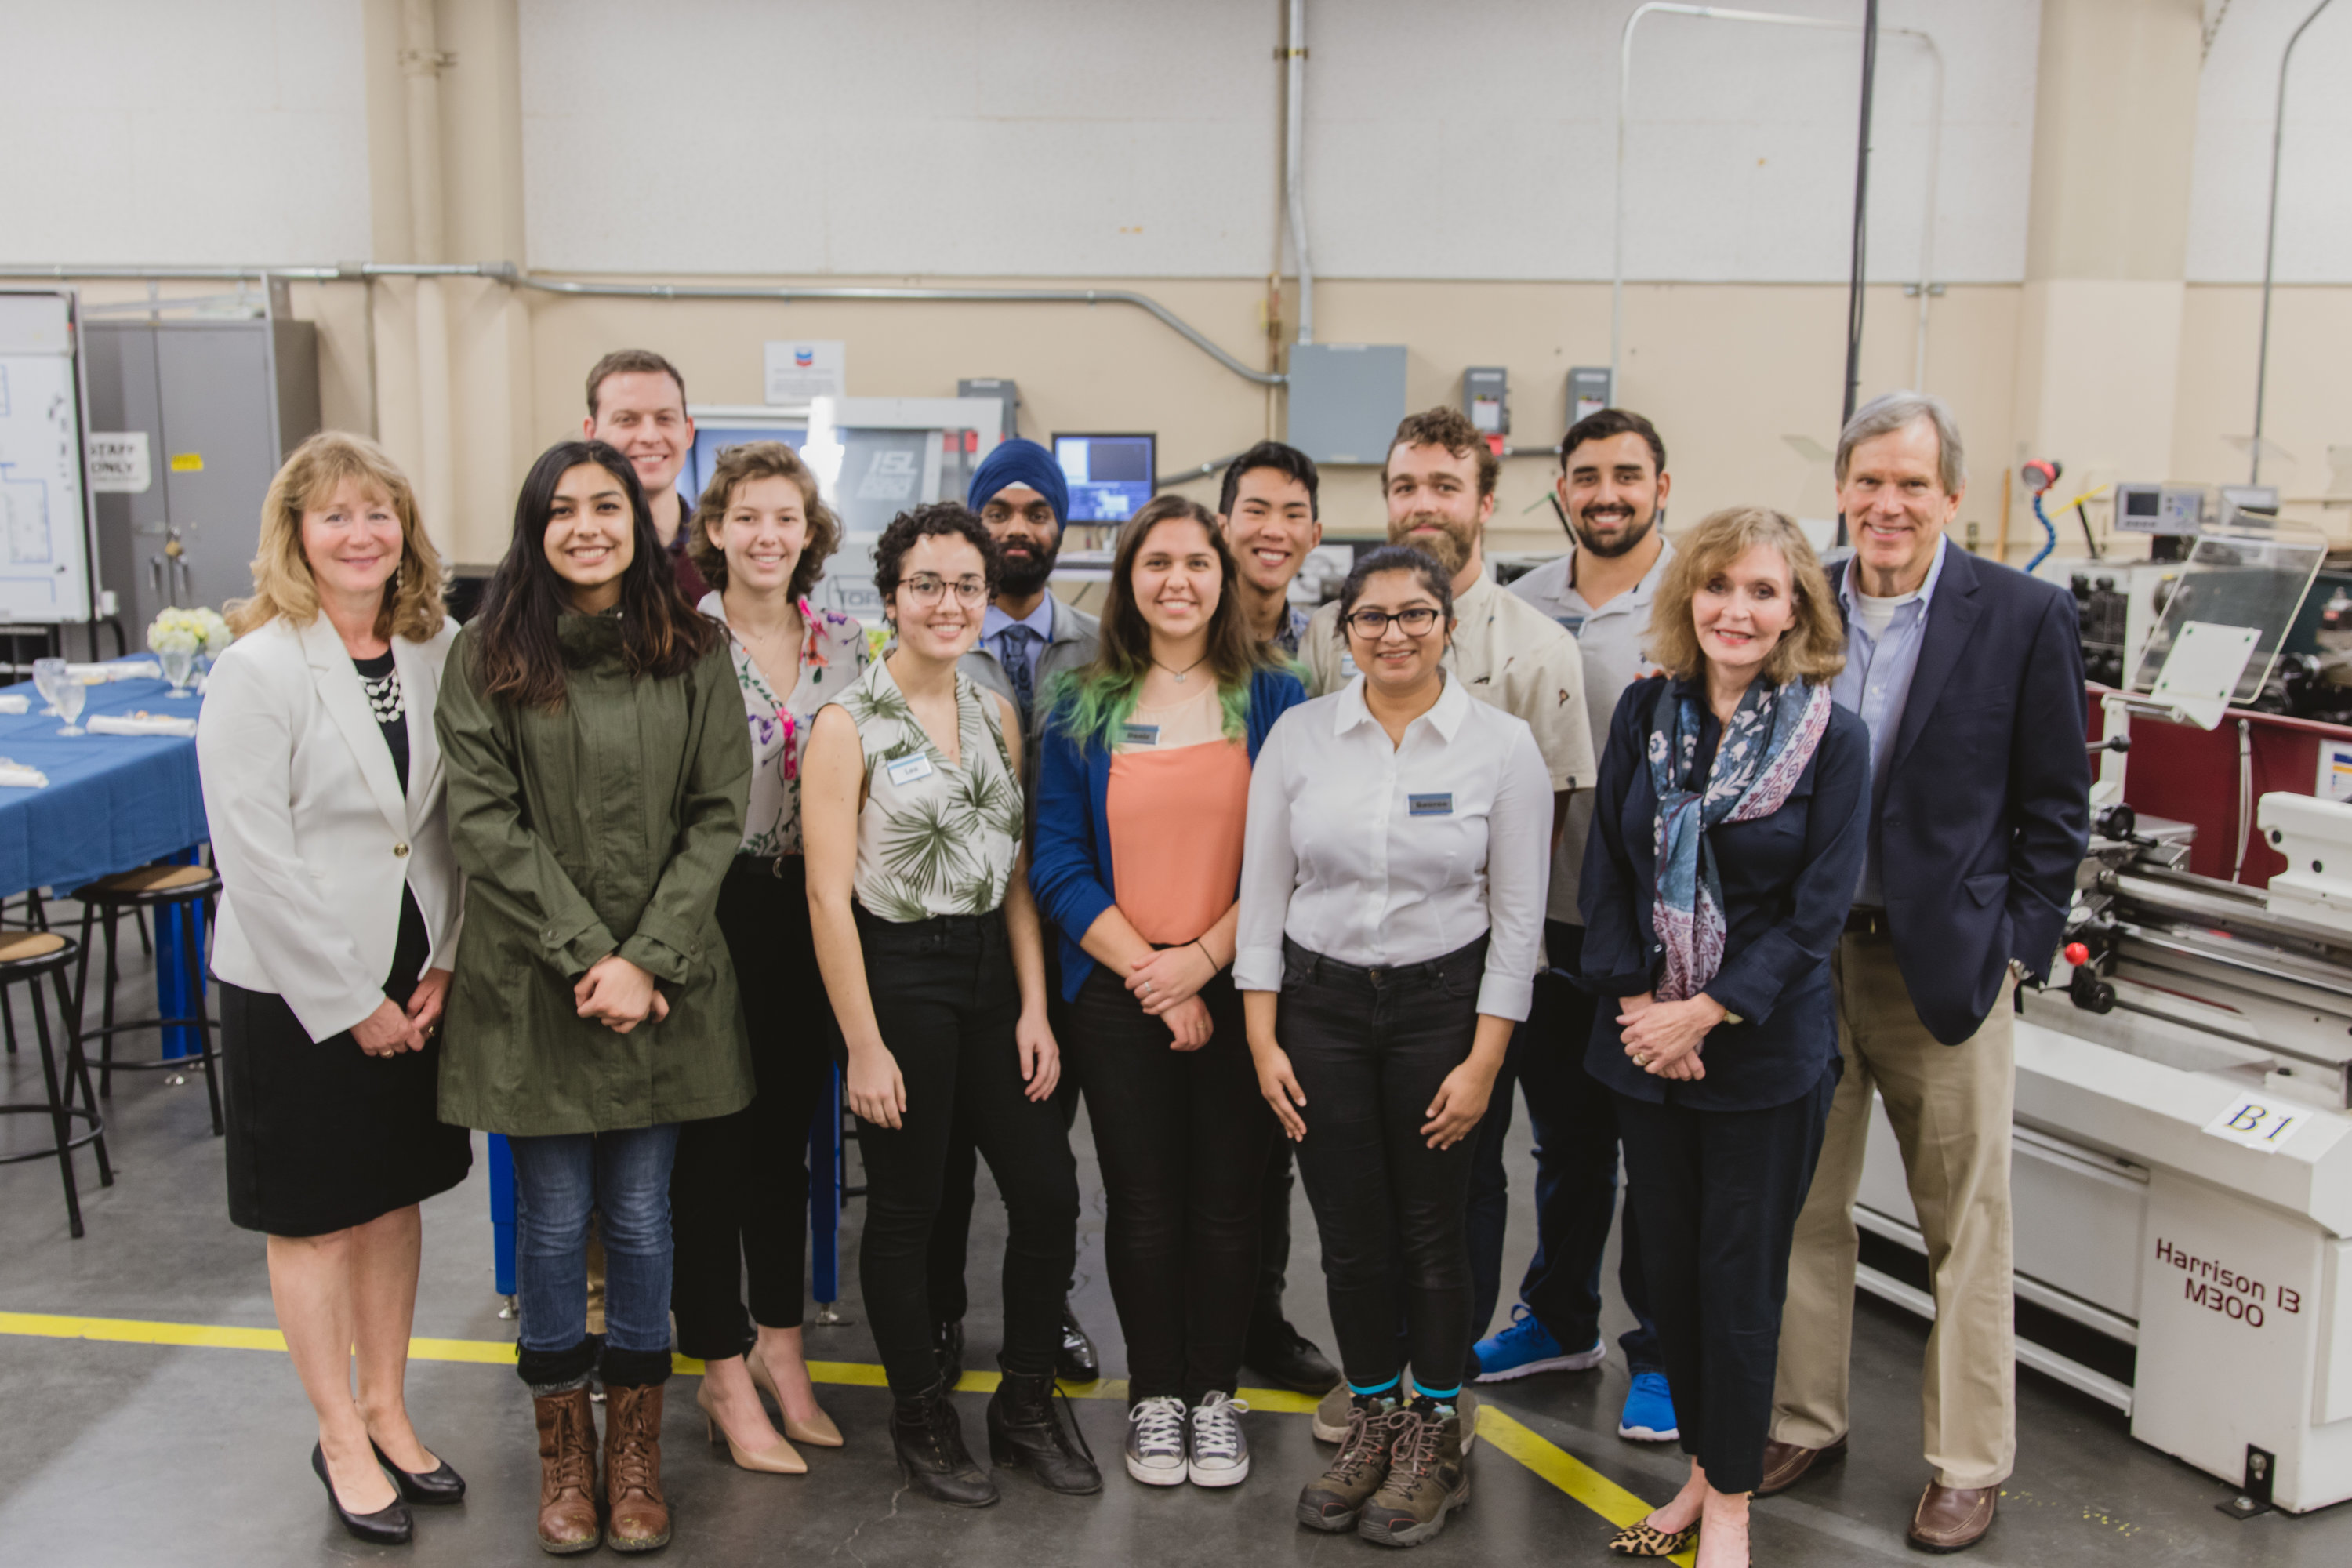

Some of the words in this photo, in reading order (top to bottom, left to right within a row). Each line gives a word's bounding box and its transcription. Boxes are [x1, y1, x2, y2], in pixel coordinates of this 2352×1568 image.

[91, 461, 132, 473] ONLY
[2223, 1104, 2295, 1142] B1
[2156, 1237, 2265, 1301] Harrison
[2184, 1277, 2265, 1328] M300
